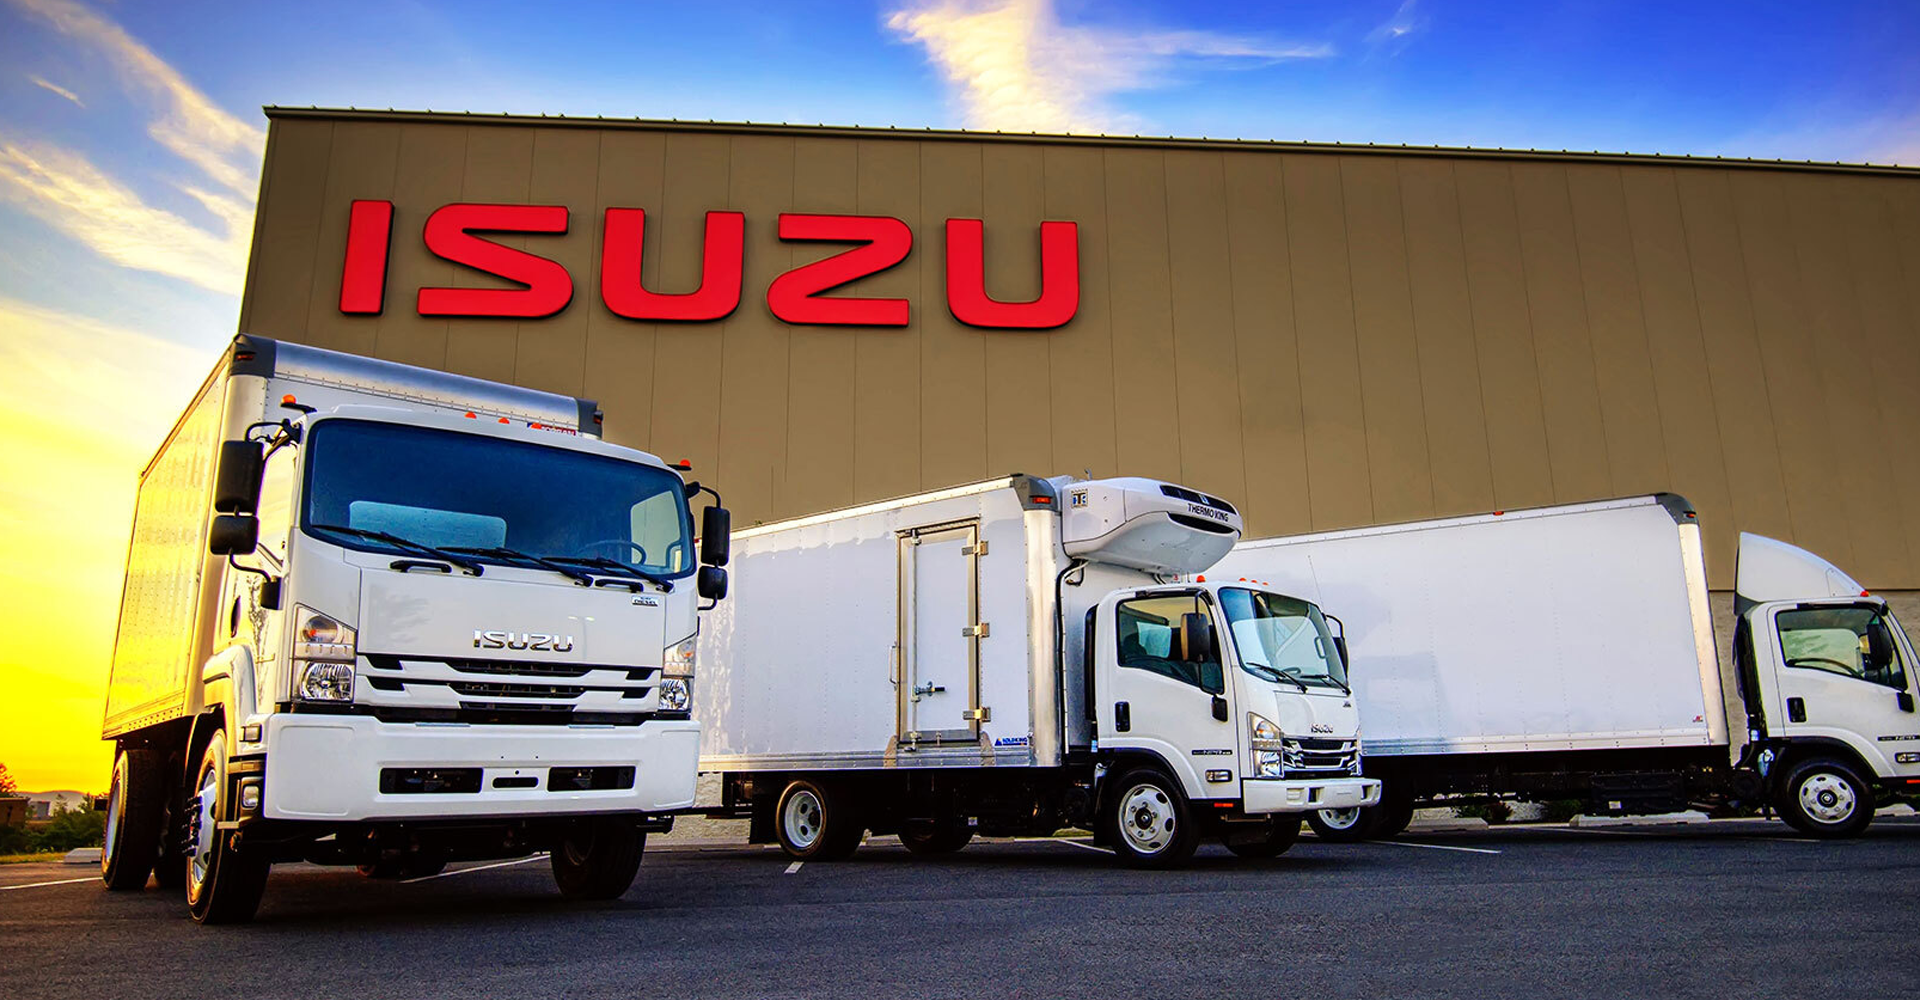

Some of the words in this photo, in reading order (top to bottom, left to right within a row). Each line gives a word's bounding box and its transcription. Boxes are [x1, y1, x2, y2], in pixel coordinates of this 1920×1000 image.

[338, 199, 1081, 331] ISUZU
[1187, 502, 1215, 518] THERMO
[1214, 510, 1229, 522] KING
[472, 628, 574, 653] ISUZU
